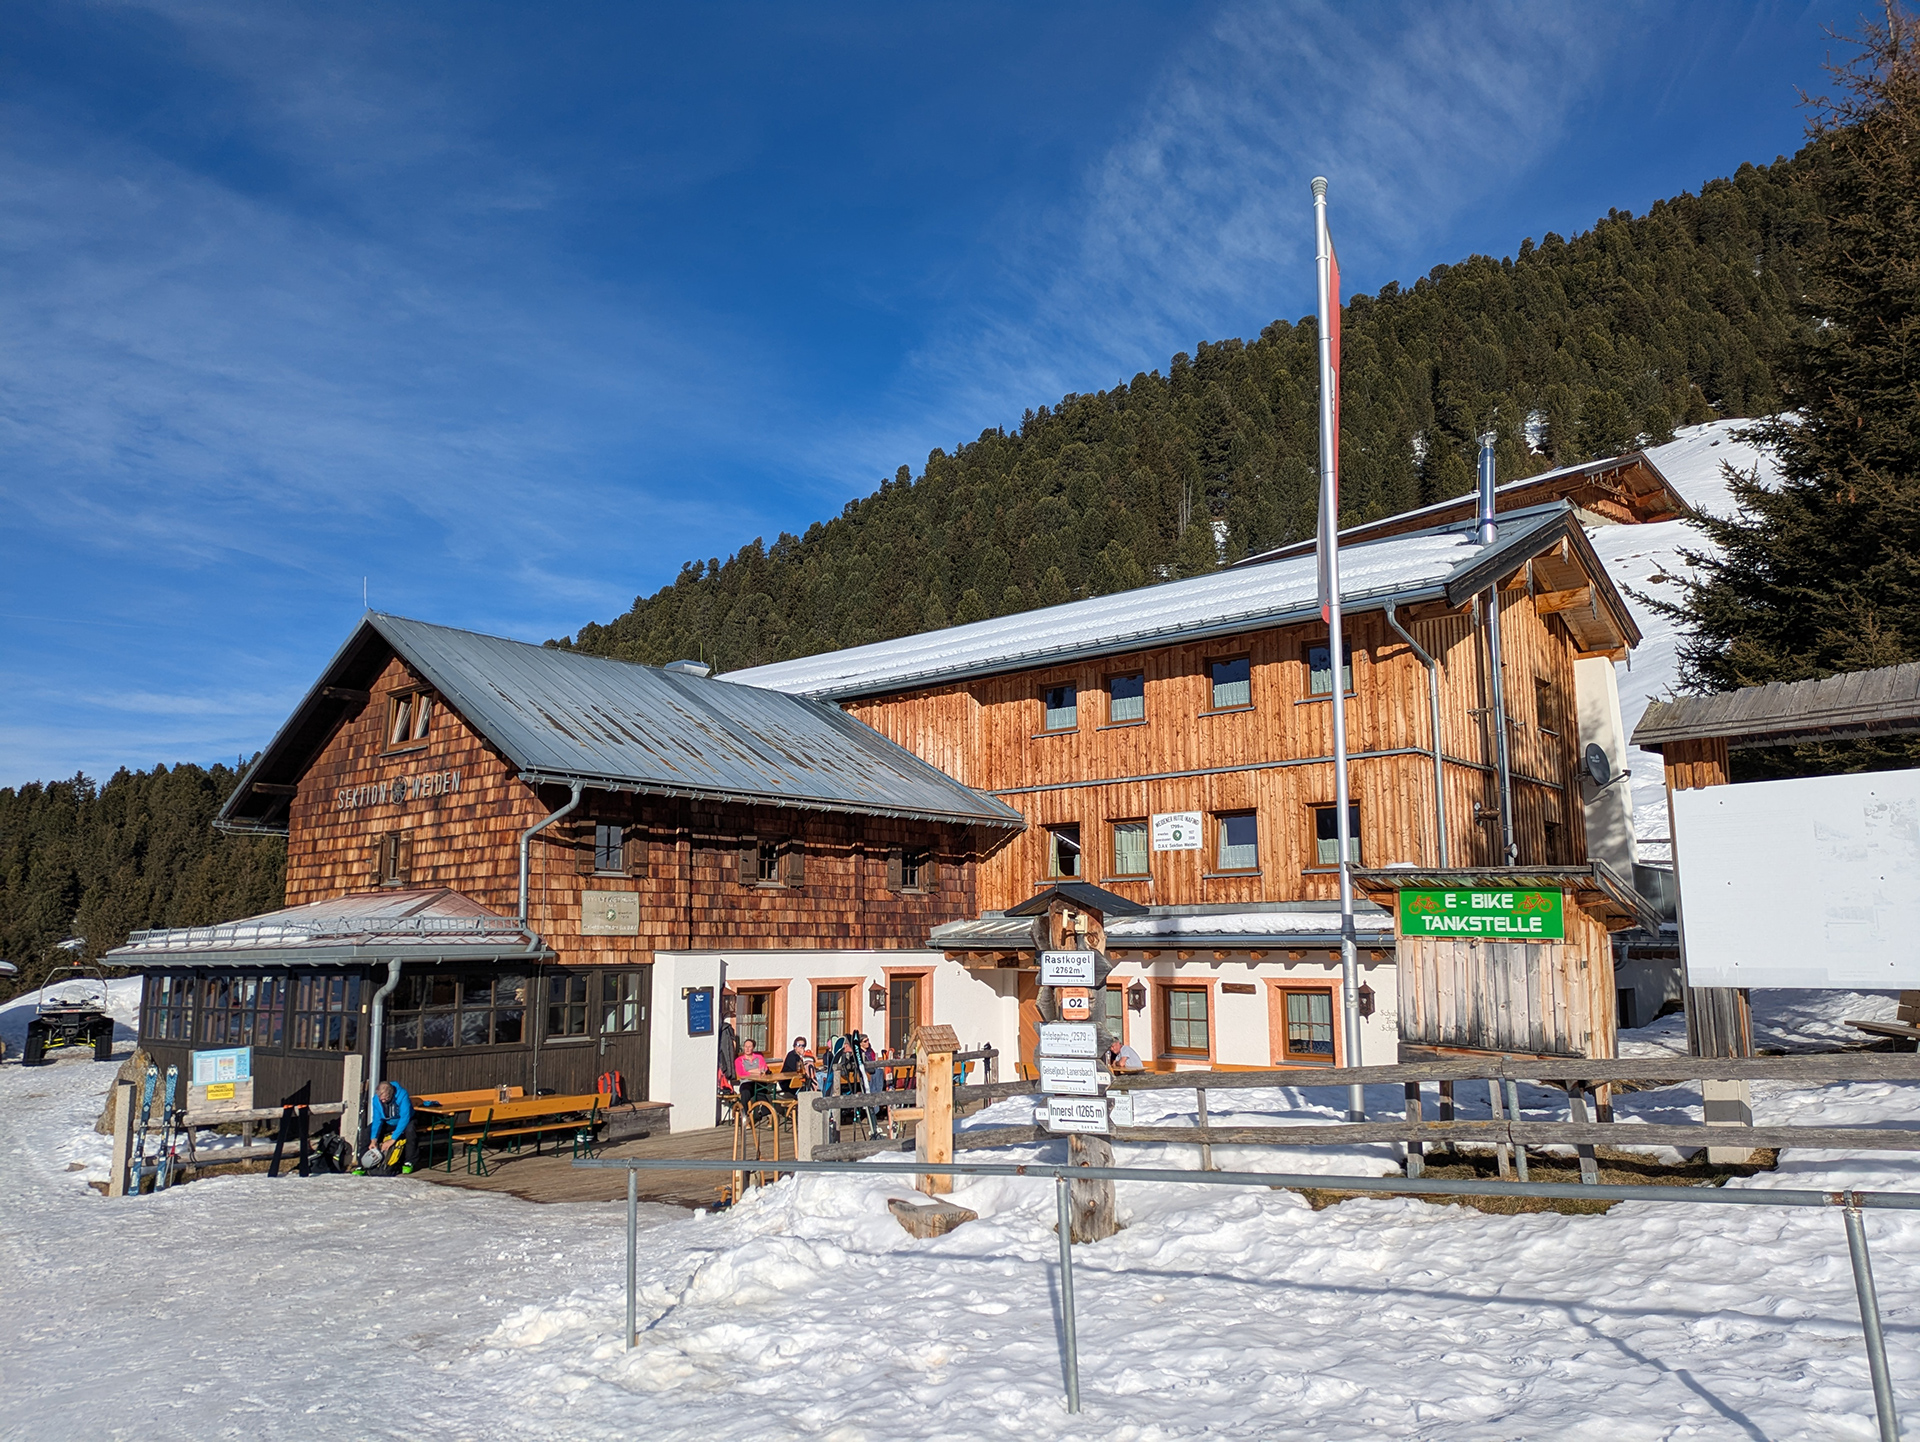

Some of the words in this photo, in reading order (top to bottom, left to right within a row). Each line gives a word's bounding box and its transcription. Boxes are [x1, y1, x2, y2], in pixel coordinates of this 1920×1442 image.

[338, 782, 387, 809] SEKTION
[412, 771, 460, 799] WEIDEN
[1471, 893, 1514, 909] BIKE
[1421, 915, 1543, 932] TANKSTELLE
[1044, 955, 1091, 966] Rastkogel
[1049, 1104, 1074, 1117] Innerst
